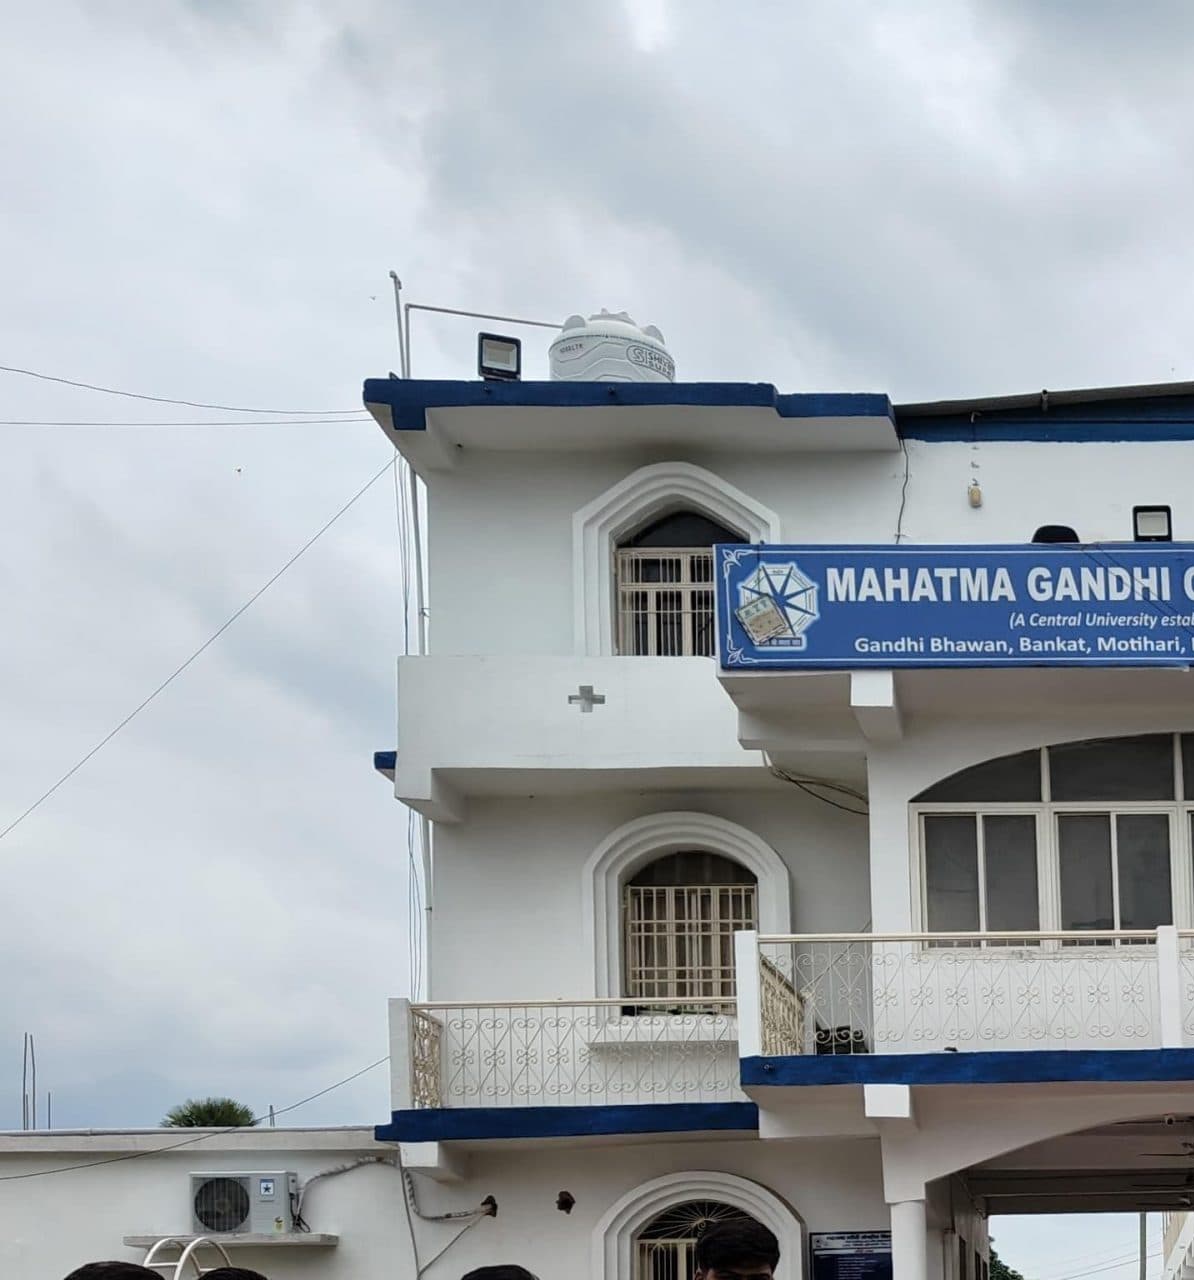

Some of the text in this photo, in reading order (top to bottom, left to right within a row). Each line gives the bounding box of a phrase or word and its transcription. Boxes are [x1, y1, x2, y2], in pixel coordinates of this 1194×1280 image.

[826, 567, 1016, 602] MAHATMA
[1027, 566, 1169, 601] GANDHI
[1009, 612, 1025, 629] (A
[1029, 612, 1080, 627] Central
[1085, 612, 1159, 630] University
[855, 637, 924, 653] Gandhi
[931, 638, 1013, 655] Bhawan,
[1020, 637, 1091, 655] Bankat,
[1097, 636, 1185, 655] Motihari,
